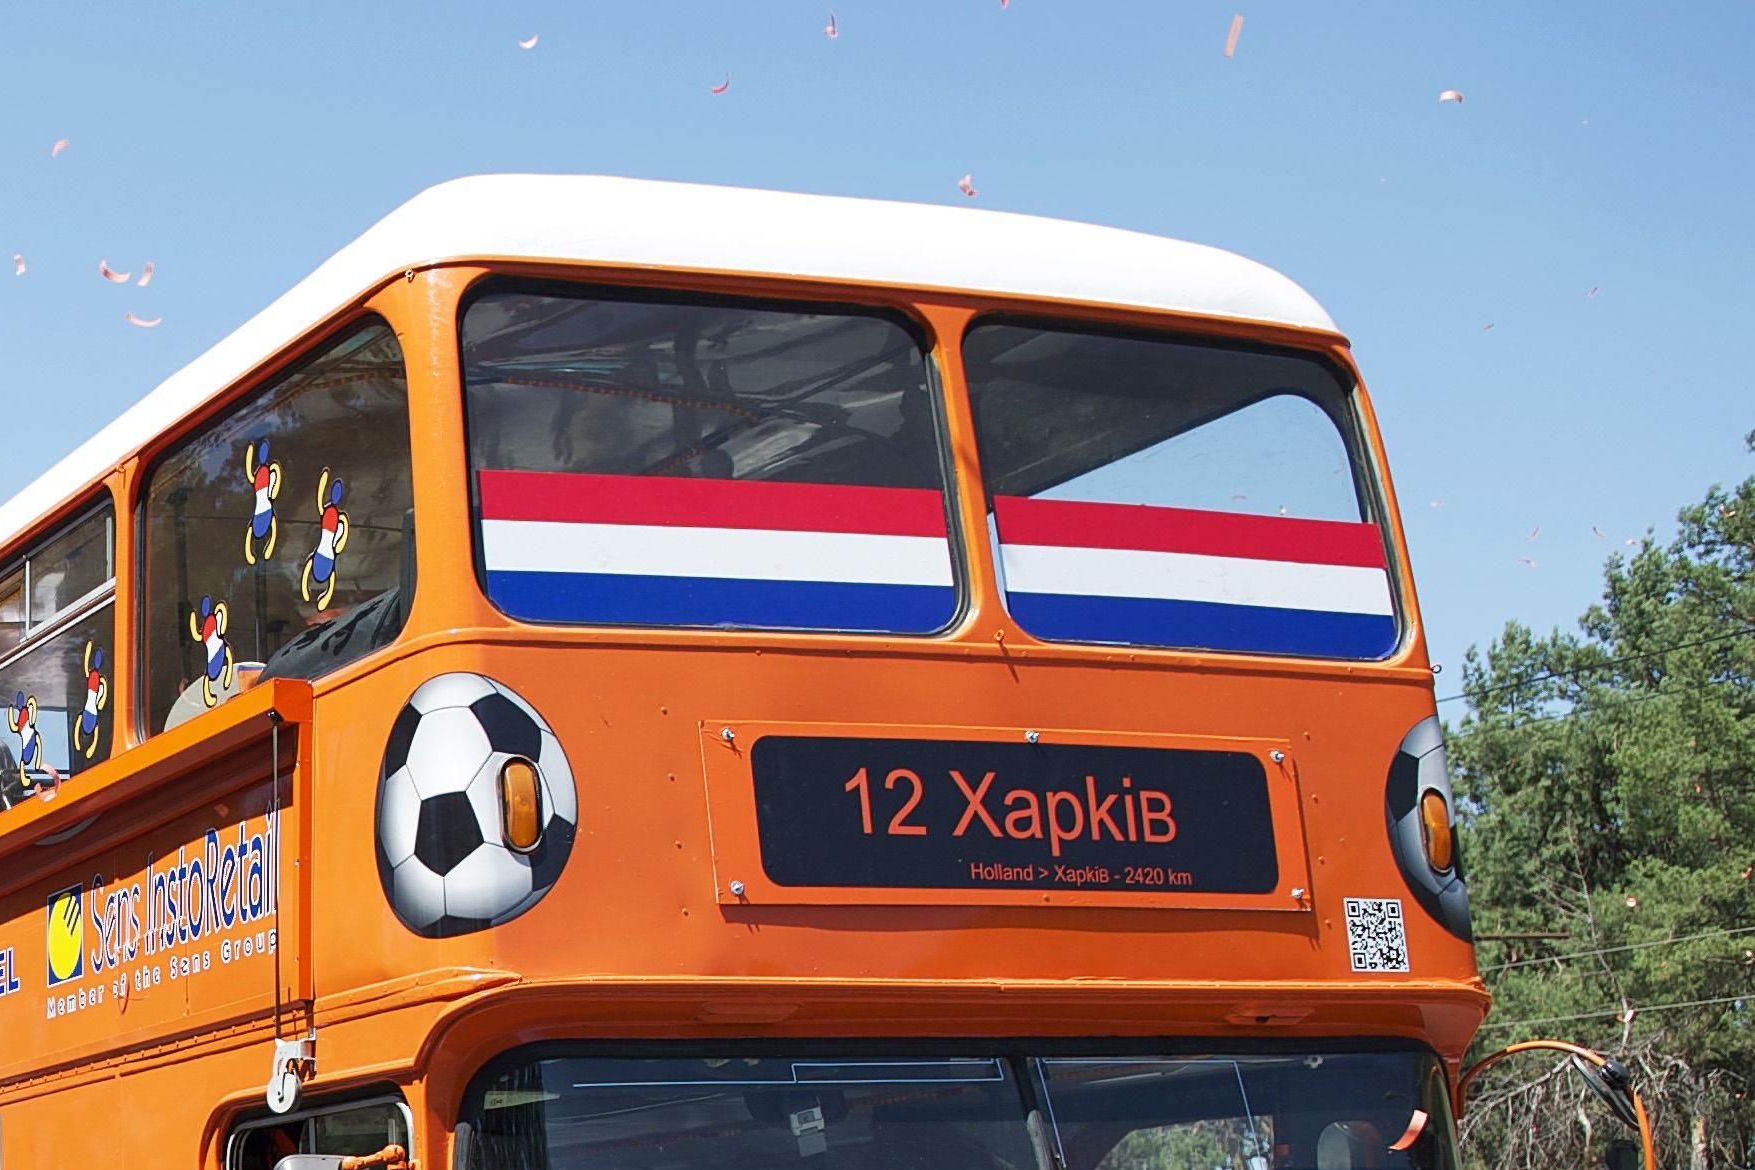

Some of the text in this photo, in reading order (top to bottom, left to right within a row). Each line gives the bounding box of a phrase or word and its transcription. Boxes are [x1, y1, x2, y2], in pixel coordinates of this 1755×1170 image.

[845, 767, 927, 835] 12
[970, 863, 1033, 881] Holland
[1124, 867, 1164, 884] 2420
[1168, 869, 1193, 885] km
[90, 872, 140, 974] Sens
[46, 928, 278, 1019] Member of the Sens Group
